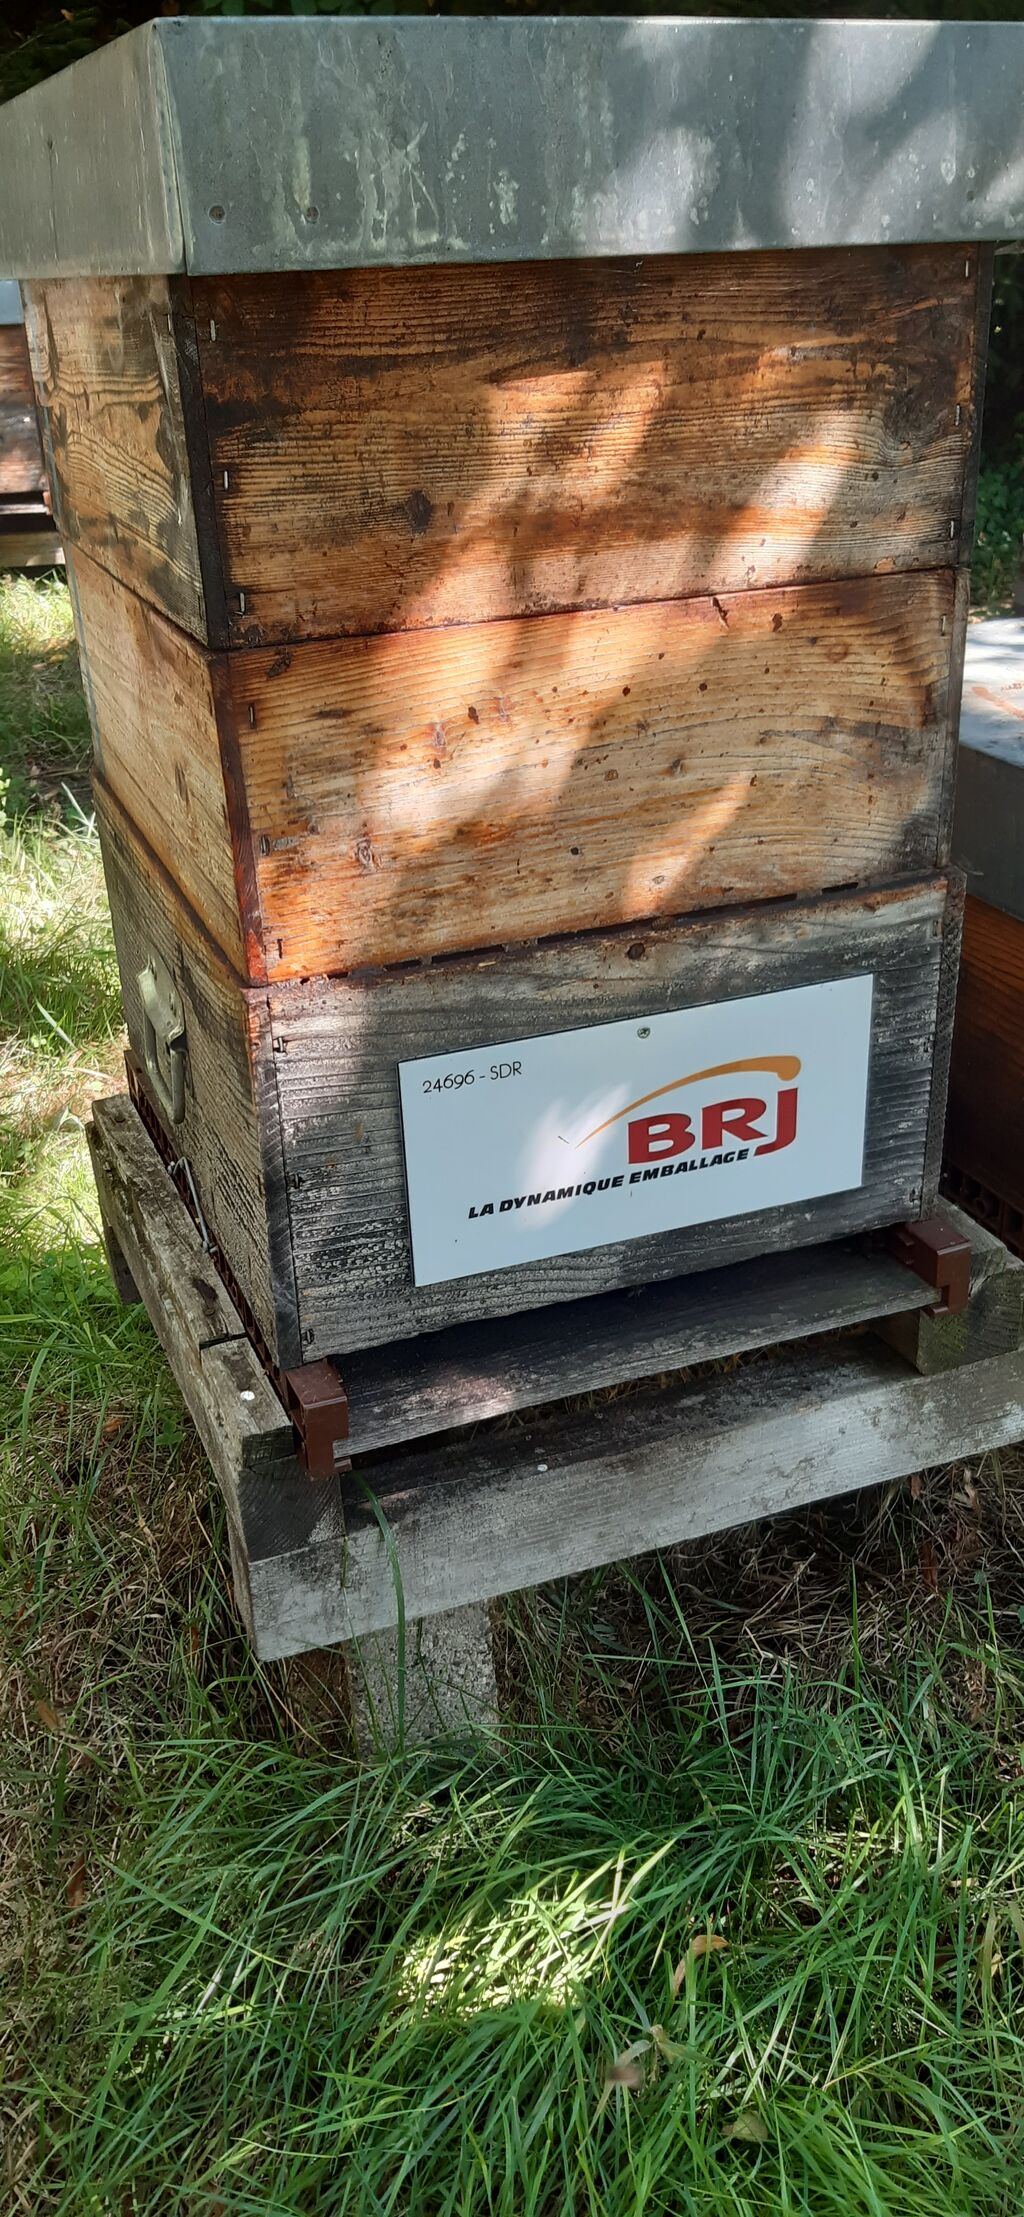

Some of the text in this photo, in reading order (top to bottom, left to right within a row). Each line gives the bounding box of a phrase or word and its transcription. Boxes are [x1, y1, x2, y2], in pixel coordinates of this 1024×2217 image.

[423, 1069, 474, 1094] 24696
[490, 1061, 522, 1081] SDR
[628, 1087, 798, 1165] BRJ
[468, 1148, 749, 1219] LA DYNAMIQUE EMBALLAGE
